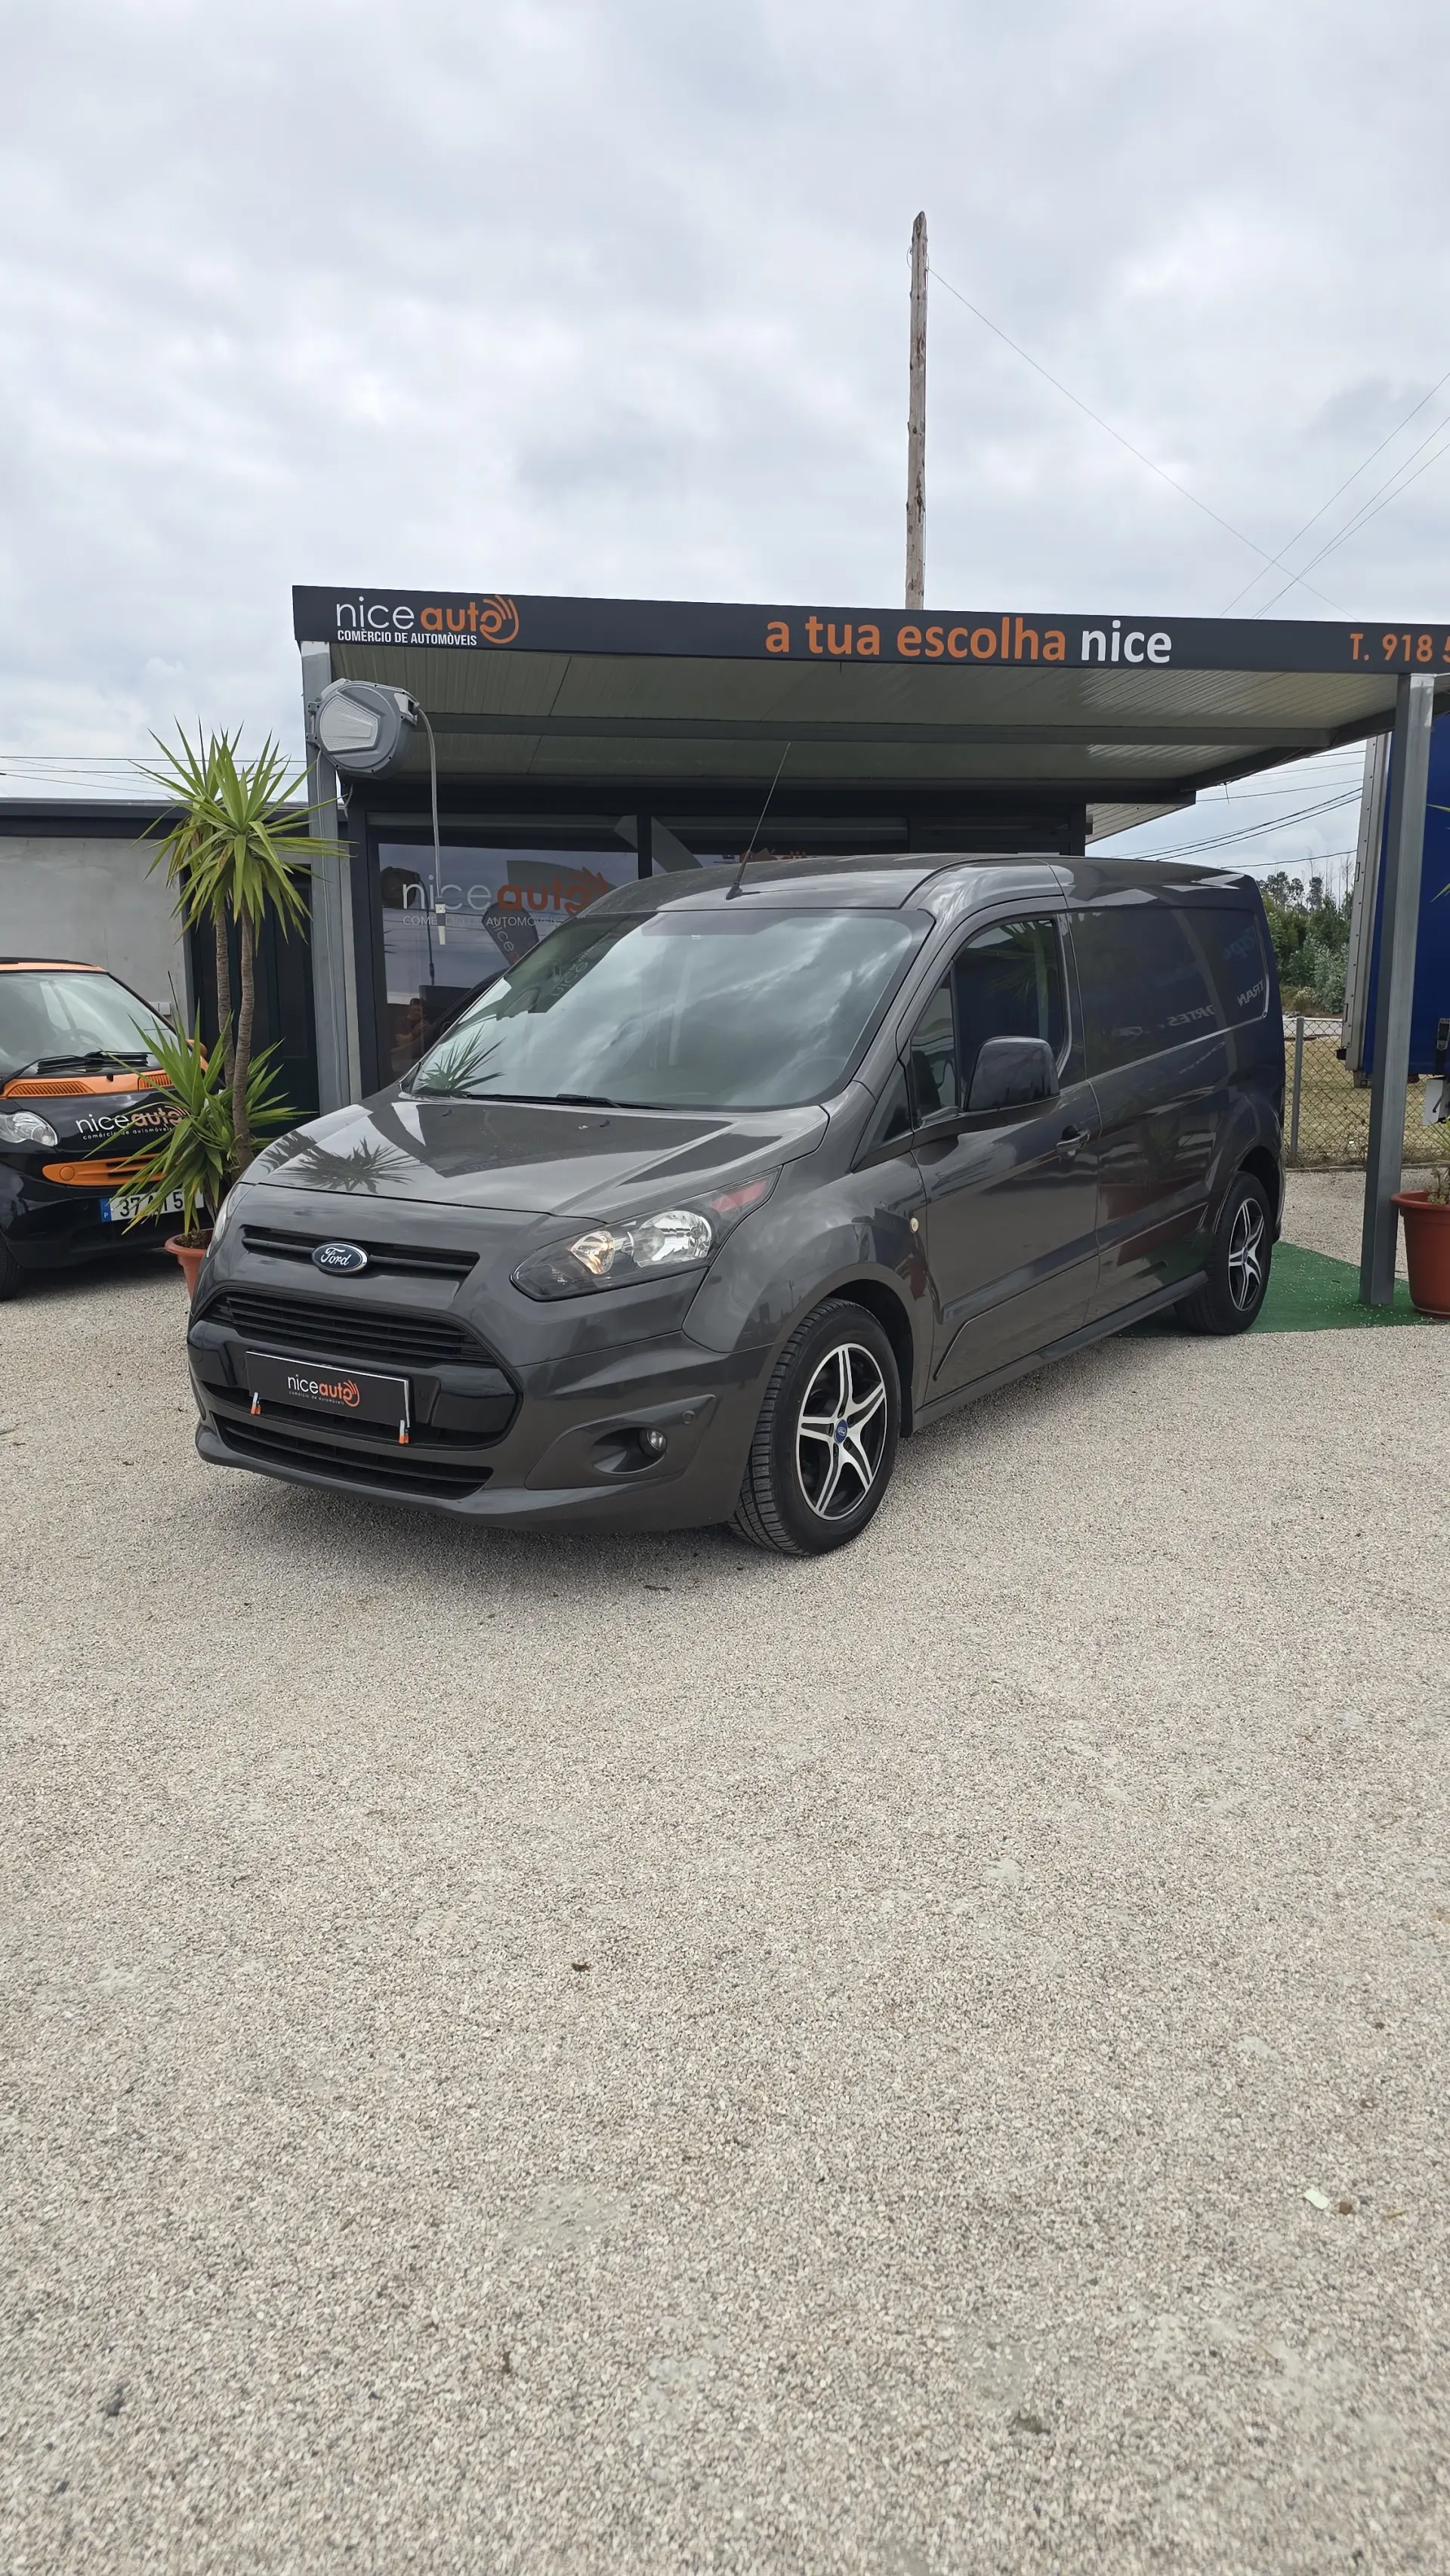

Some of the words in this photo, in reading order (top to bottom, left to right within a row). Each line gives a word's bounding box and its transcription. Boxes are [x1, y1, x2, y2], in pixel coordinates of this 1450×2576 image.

[394, 632, 409, 644] DE
[765, 621, 789, 653] a
[805, 616, 880, 655] tua
[897, 616, 1066, 661] escolha
[1081, 619, 1172, 663] nice
[1350, 633, 1369, 661] T.
[1382, 634, 1433, 663] 918
[320, 1246, 352, 1266] Ford
